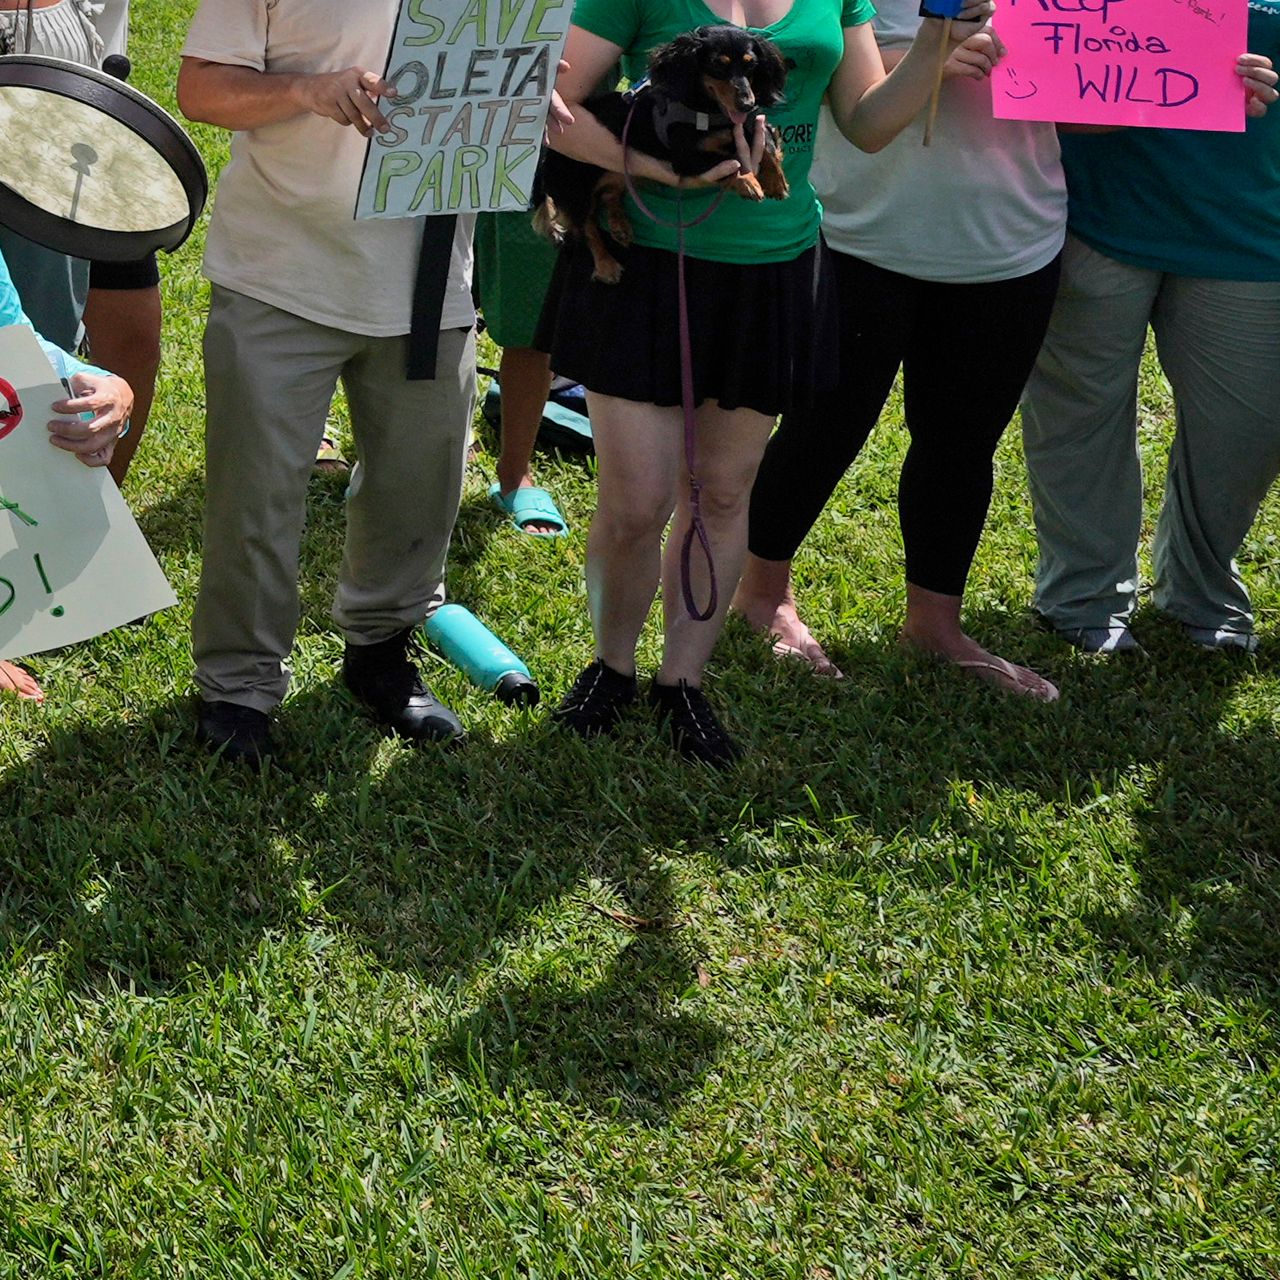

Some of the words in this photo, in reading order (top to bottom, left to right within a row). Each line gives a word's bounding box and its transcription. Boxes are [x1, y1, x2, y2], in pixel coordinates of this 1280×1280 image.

[1030, 21, 1172, 55] Florida
[387, 43, 552, 107] OLETA
[1074, 62, 1200, 108] WILD
[375, 98, 543, 148] STATE
[373, 145, 538, 213] PARK
